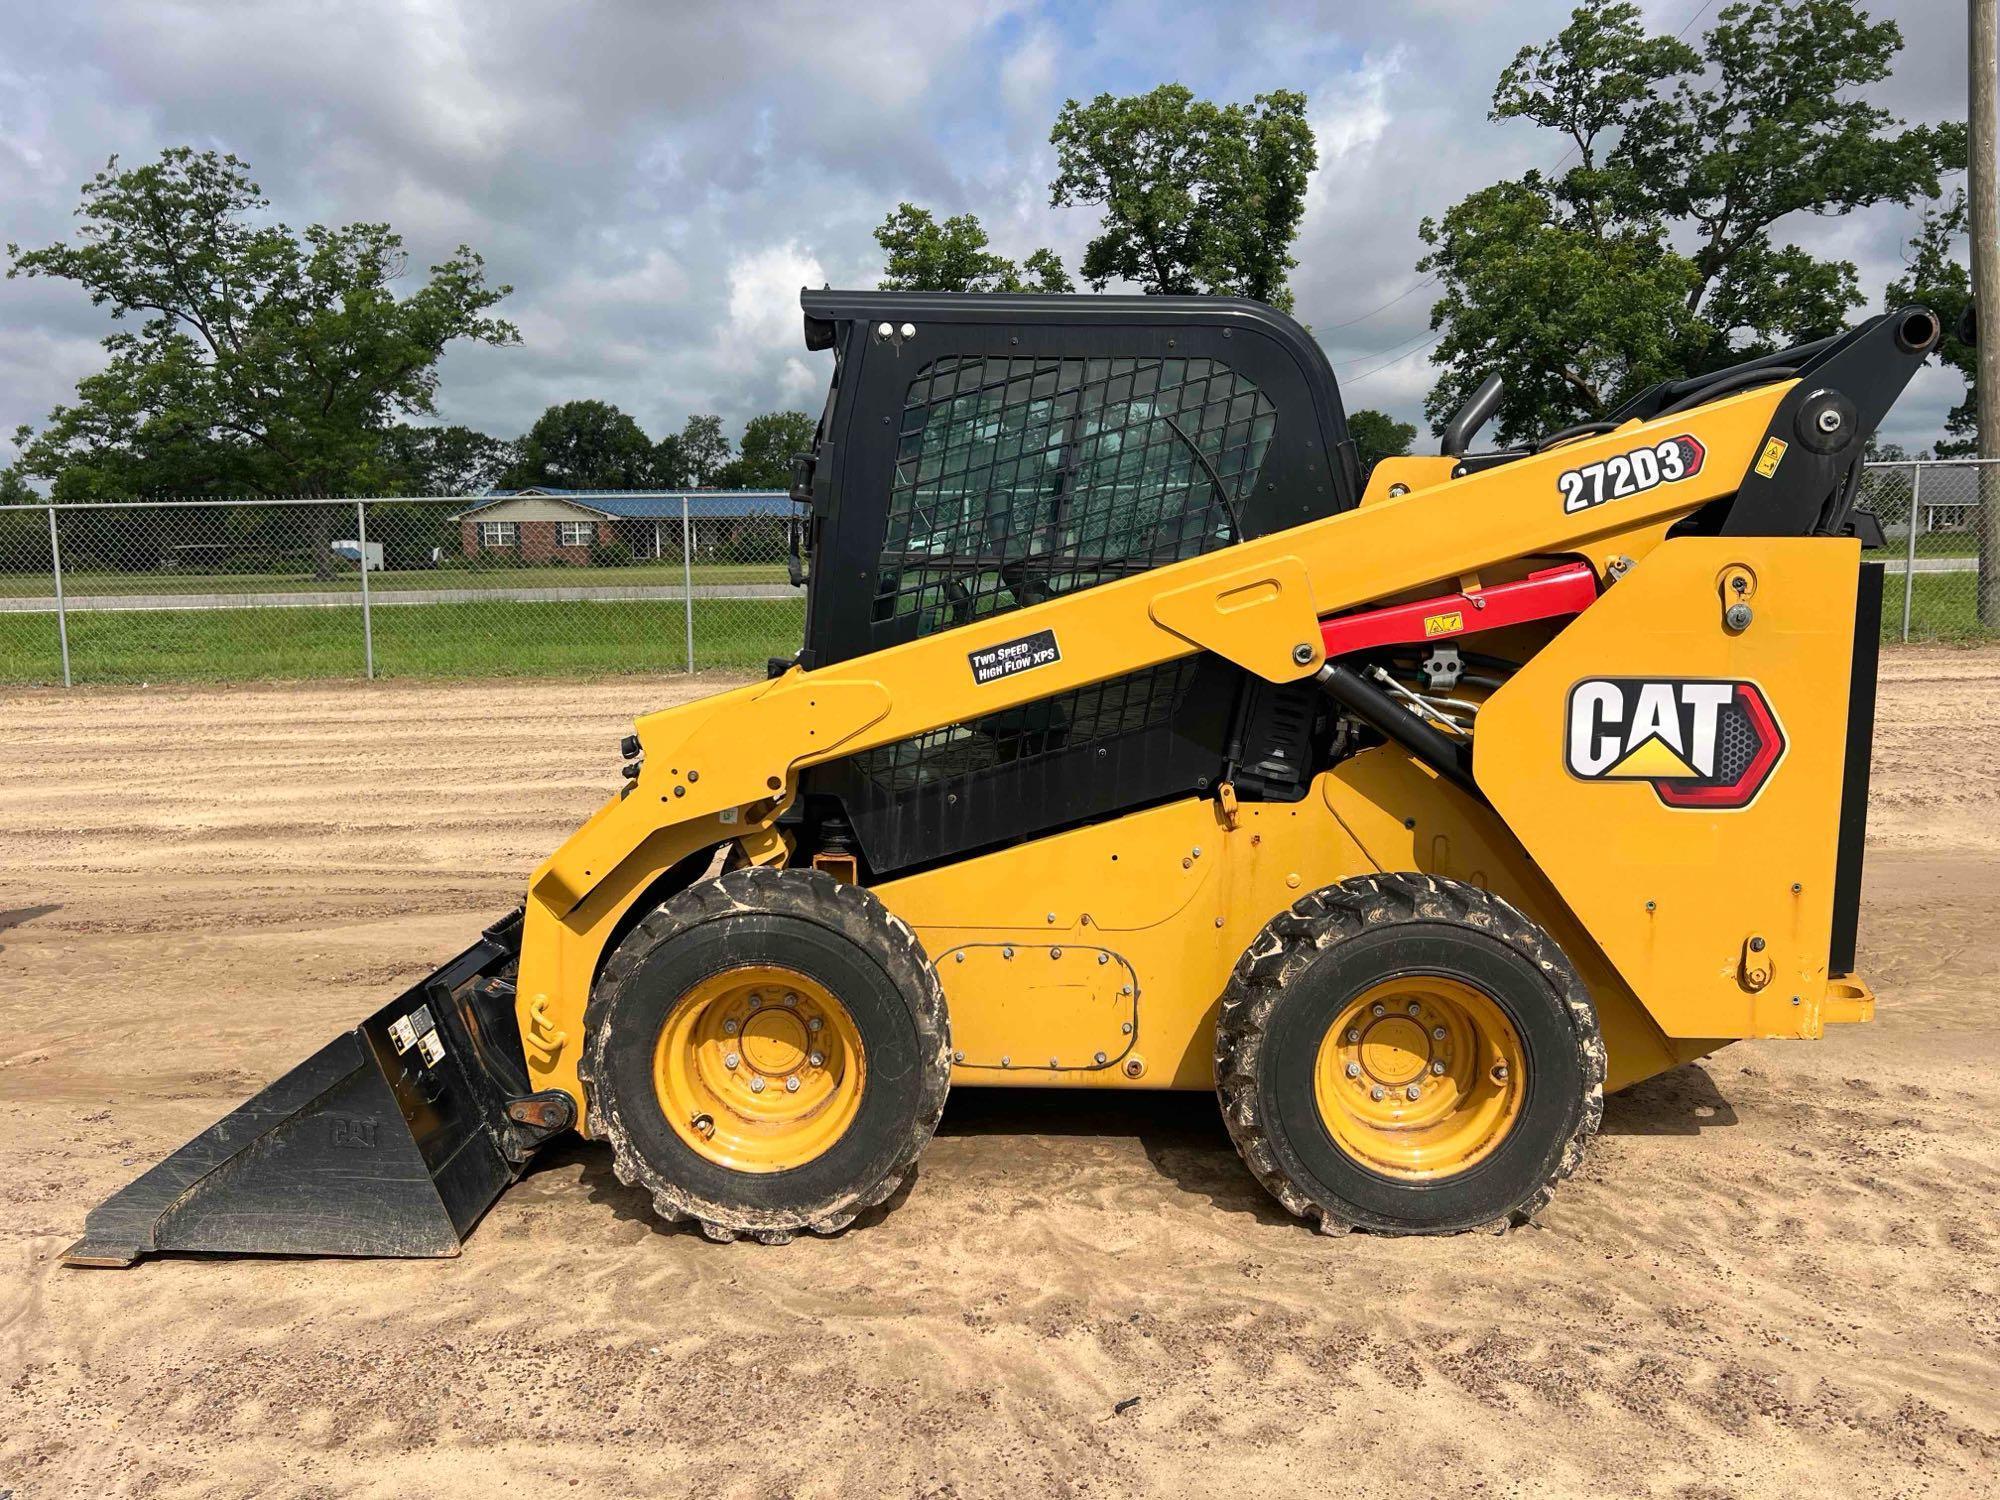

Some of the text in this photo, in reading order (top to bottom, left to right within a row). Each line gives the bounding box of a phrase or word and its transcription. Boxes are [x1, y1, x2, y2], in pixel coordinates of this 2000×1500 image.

[1560, 441, 1685, 513] 272D3
[973, 643, 1029, 668] TWO SPEED
[979, 648, 1055, 681] HIGH FLOW XPS
[1570, 681, 1733, 778] CAT
[332, 1119, 378, 1148] CAT
